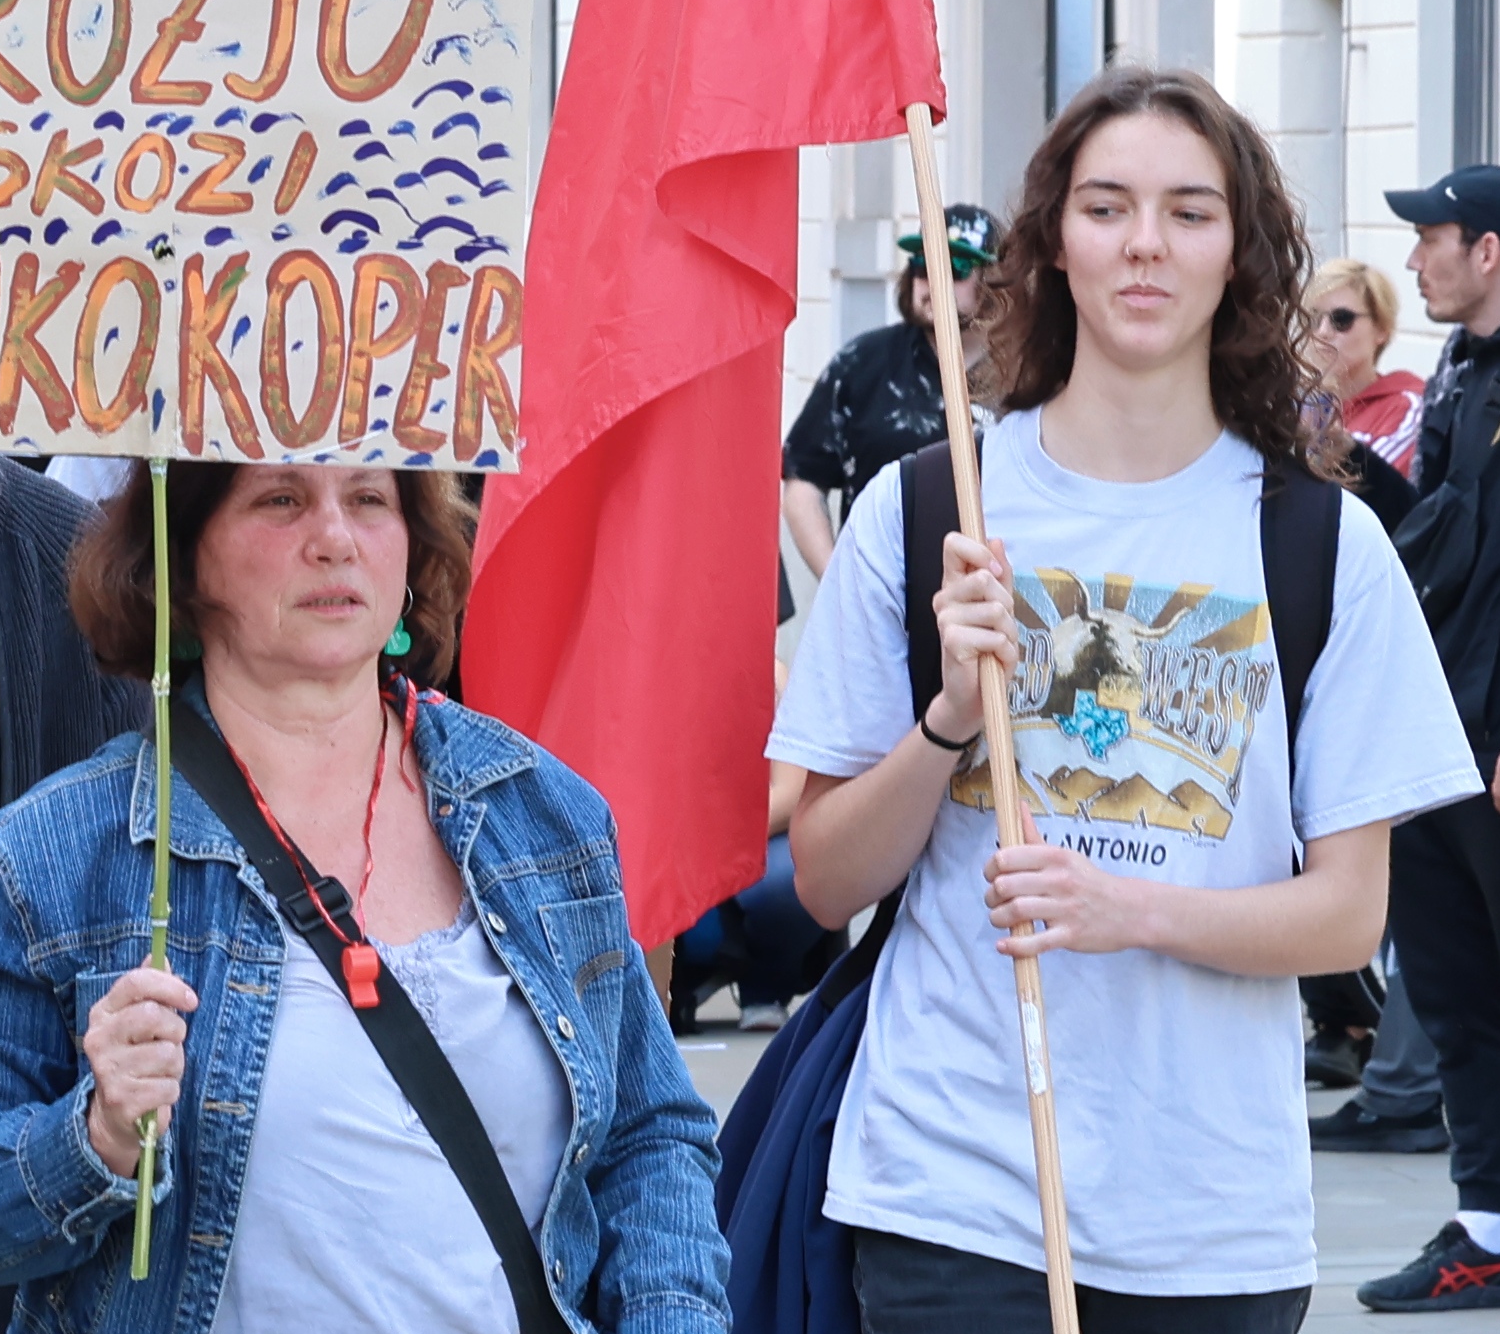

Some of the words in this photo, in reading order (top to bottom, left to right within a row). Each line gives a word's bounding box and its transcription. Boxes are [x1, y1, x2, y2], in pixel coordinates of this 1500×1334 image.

[178, 246, 523, 461] KOPER
[1138, 642, 1275, 807] WEST
[973, 791, 1206, 839] TXAS
